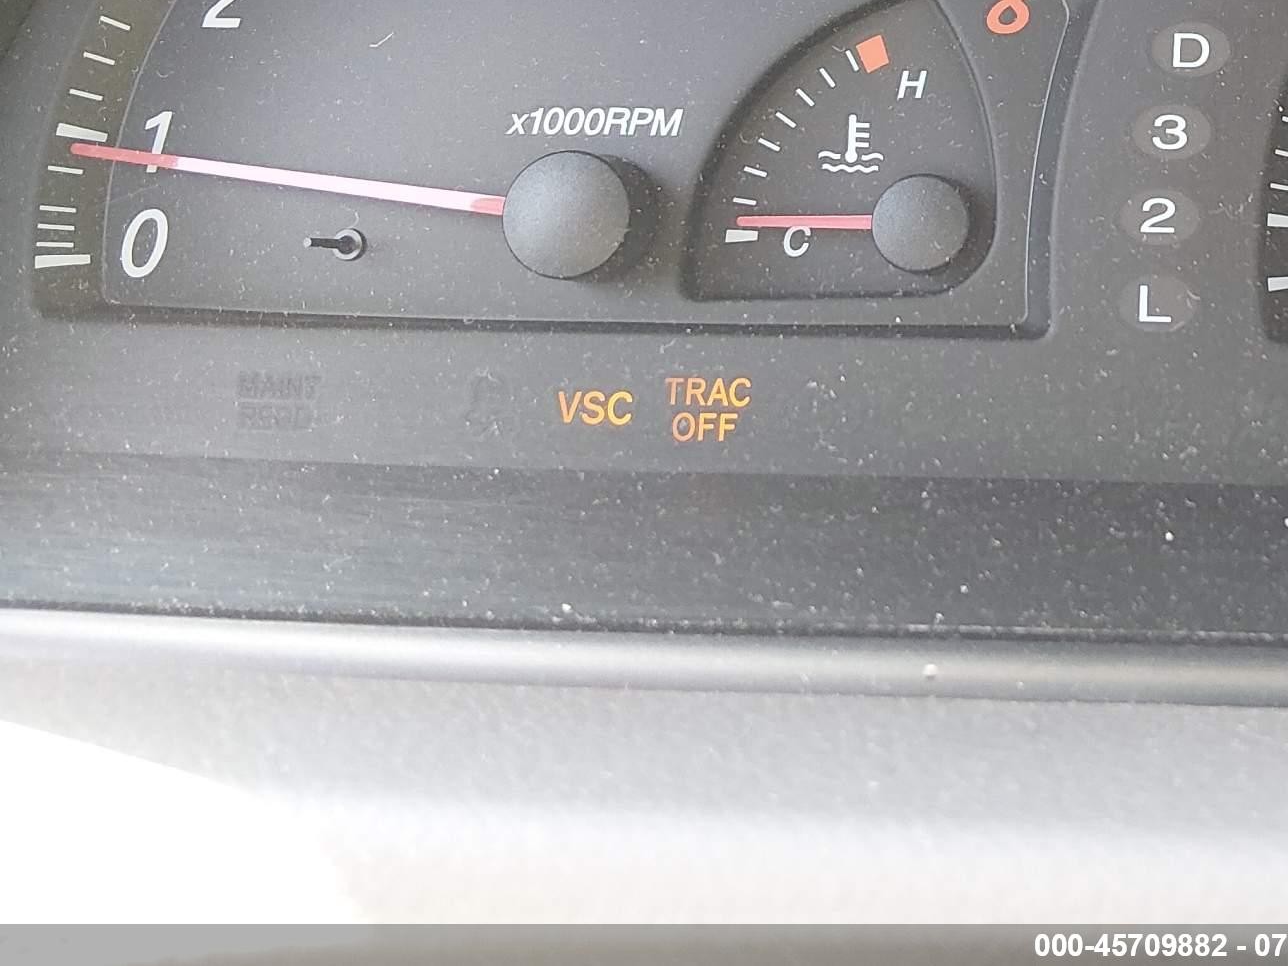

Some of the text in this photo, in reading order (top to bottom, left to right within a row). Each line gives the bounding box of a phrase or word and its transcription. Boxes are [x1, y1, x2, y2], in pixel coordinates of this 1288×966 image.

[1172, 33, 1210, 68] D
[896, 70, 927, 99] H
[505, 107, 684, 137] x1000RPM
[1151, 115, 1188, 150] 3
[142, 111, 173, 173] 1
[1141, 197, 1175, 233] 2
[119, 208, 169, 278] 0
[782, 226, 811, 257] C
[1139, 285, 1172, 323] L
[557, 391, 634, 425] VSC
[664, 377, 752, 408] TRAC
[671, 411, 738, 442] OFF
